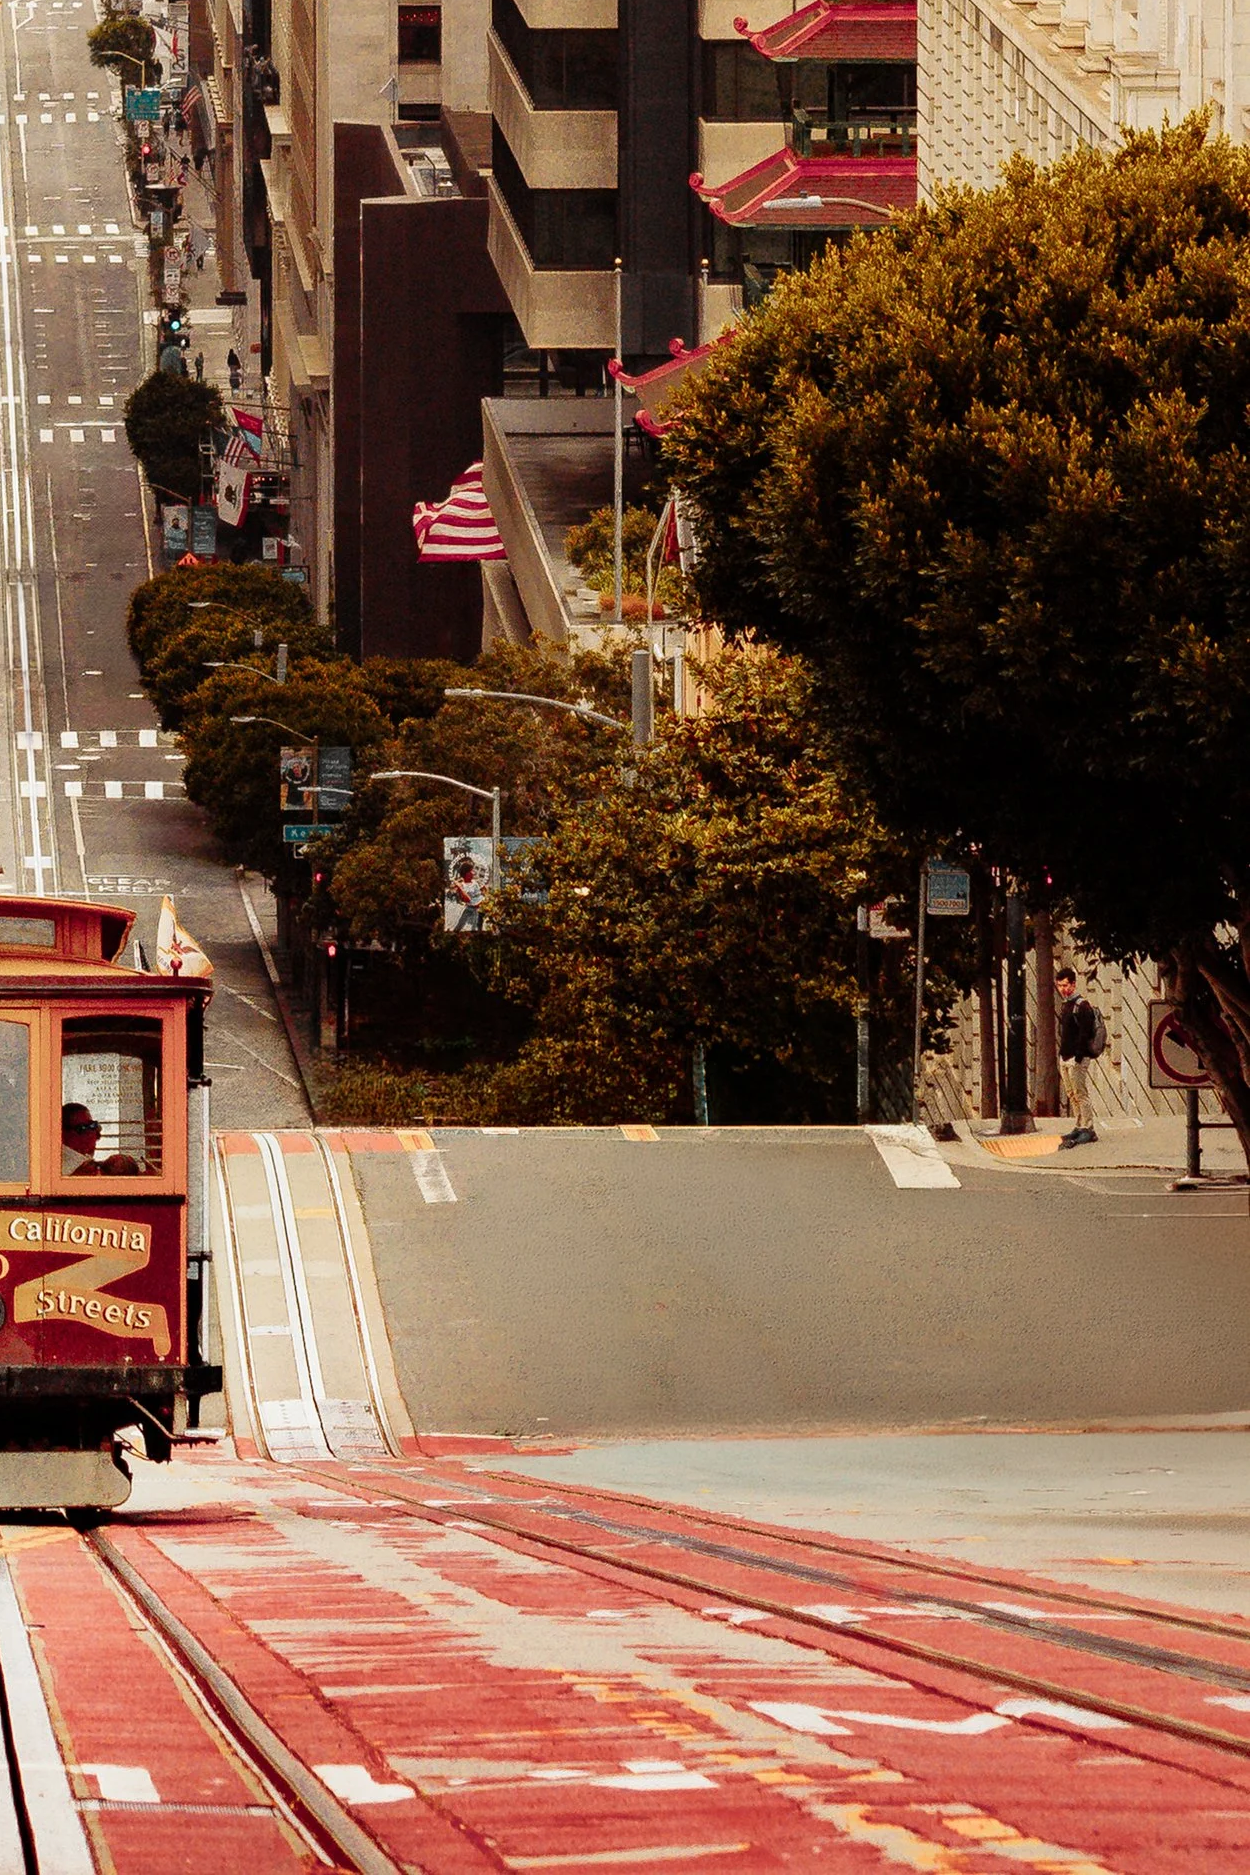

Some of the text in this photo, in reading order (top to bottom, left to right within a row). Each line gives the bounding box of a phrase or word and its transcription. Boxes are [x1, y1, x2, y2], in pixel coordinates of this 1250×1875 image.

[88, 878, 171, 886] CLEAR
[9, 1217, 146, 1252] California
[36, 1289, 152, 1330] Streets
